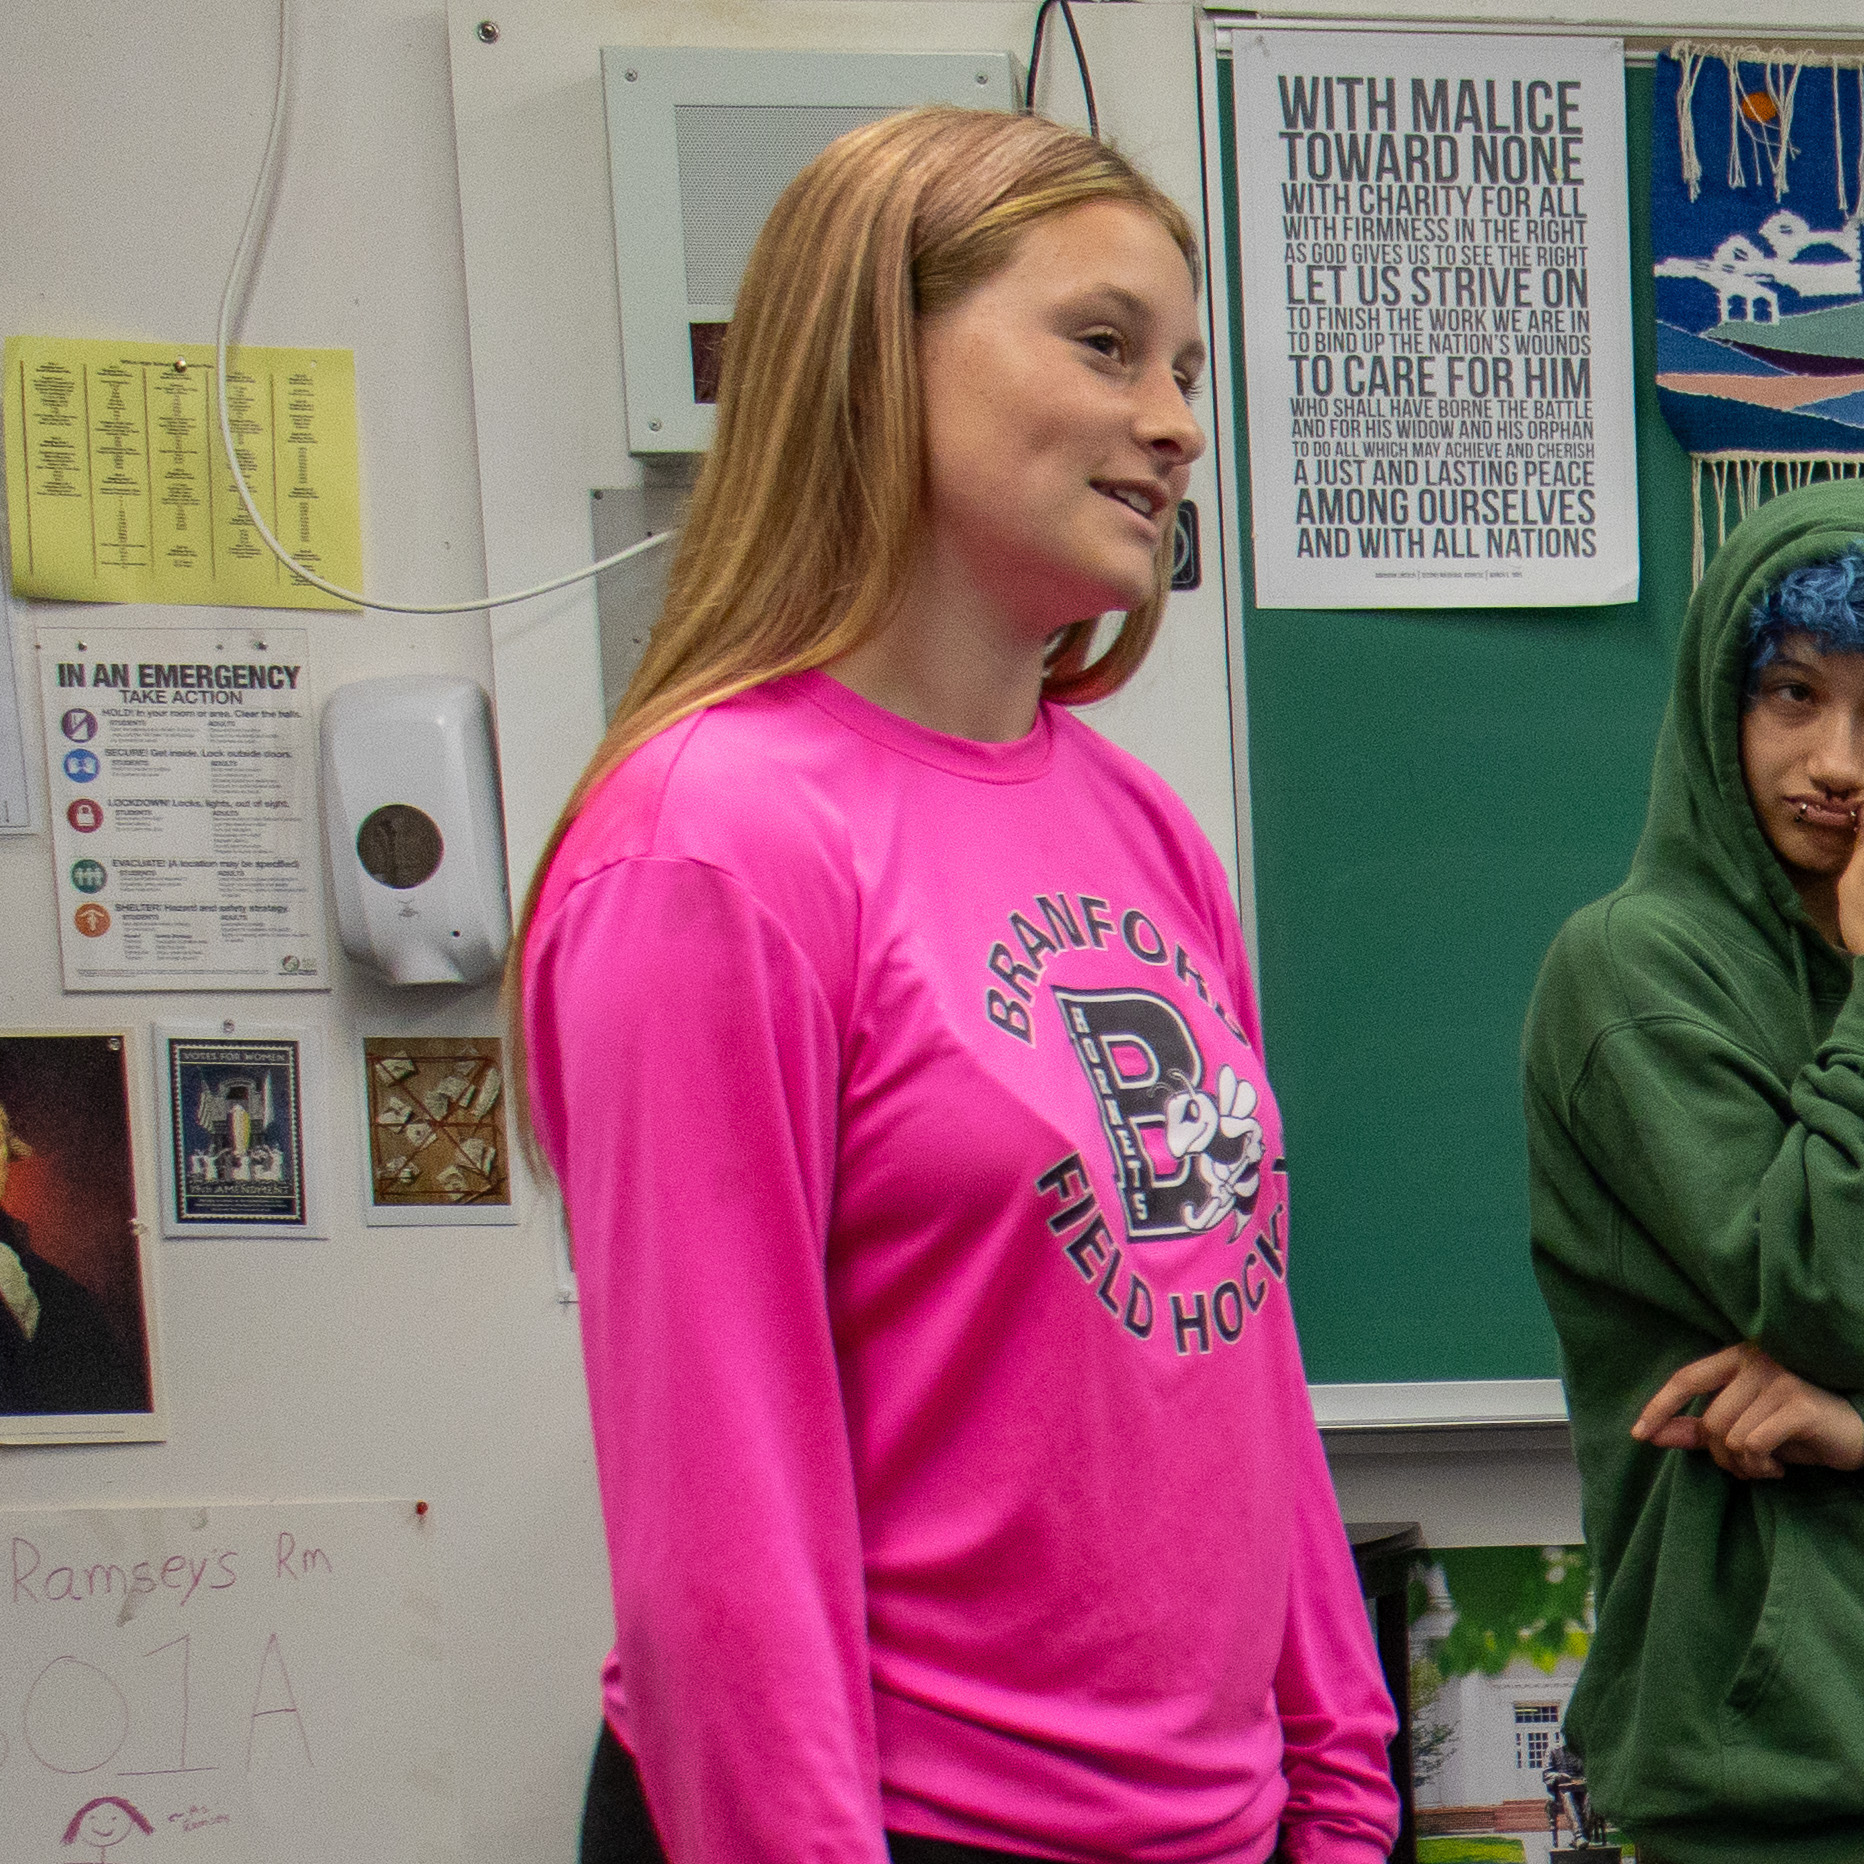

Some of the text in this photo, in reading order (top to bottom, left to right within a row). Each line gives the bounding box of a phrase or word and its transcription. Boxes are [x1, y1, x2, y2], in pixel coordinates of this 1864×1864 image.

[1278, 75, 1582, 135] WITH MALICE
[1279, 132, 1584, 185] TOWARD NONE
[1282, 183, 1587, 218] WITH CHARITY FOR ALL
[1283, 216, 1586, 244] WITH FIRMNESS IN THE RIGHT
[1285, 243, 1588, 267] AS GOD GIVES US TO SEE THE RIGHT
[1287, 265, 1588, 309] LET US STRIVE ON
[1287, 307, 1589, 333] TO FINISH THE WORK WE ARE IN
[1287, 332, 1591, 356] TO BIND UP THE NATION'S WOUNDS
[1289, 355, 1590, 399] TO CARE FOR HIM
[1290, 398, 1592, 419] WHO SHALL HAVE BORNE THE BATTLE
[1292, 419, 1593, 439] AND FOR HIS WIDOW AND HIS ORPHAN
[1292, 441, 1594, 458] TO DO ALL WHICH MAY ACHIEVE AND CHERISH
[1294, 459, 1594, 486] A JUST AND LASTING PEACE
[1296, 488, 1595, 525] AMONG OURSELVES
[1297, 528, 1596, 558] AND WITH ALL NATIONS
[57, 663, 300, 689] IN AN EMERGENCY
[119, 690, 242, 705] TAKE ACTION
[1072, 1006, 1148, 1221] HORNETS
[1035, 1152, 1288, 1355] FIELD HOCK
[276, 1531, 333, 1581] Rm
[0, 1633, 314, 1775] 01A
